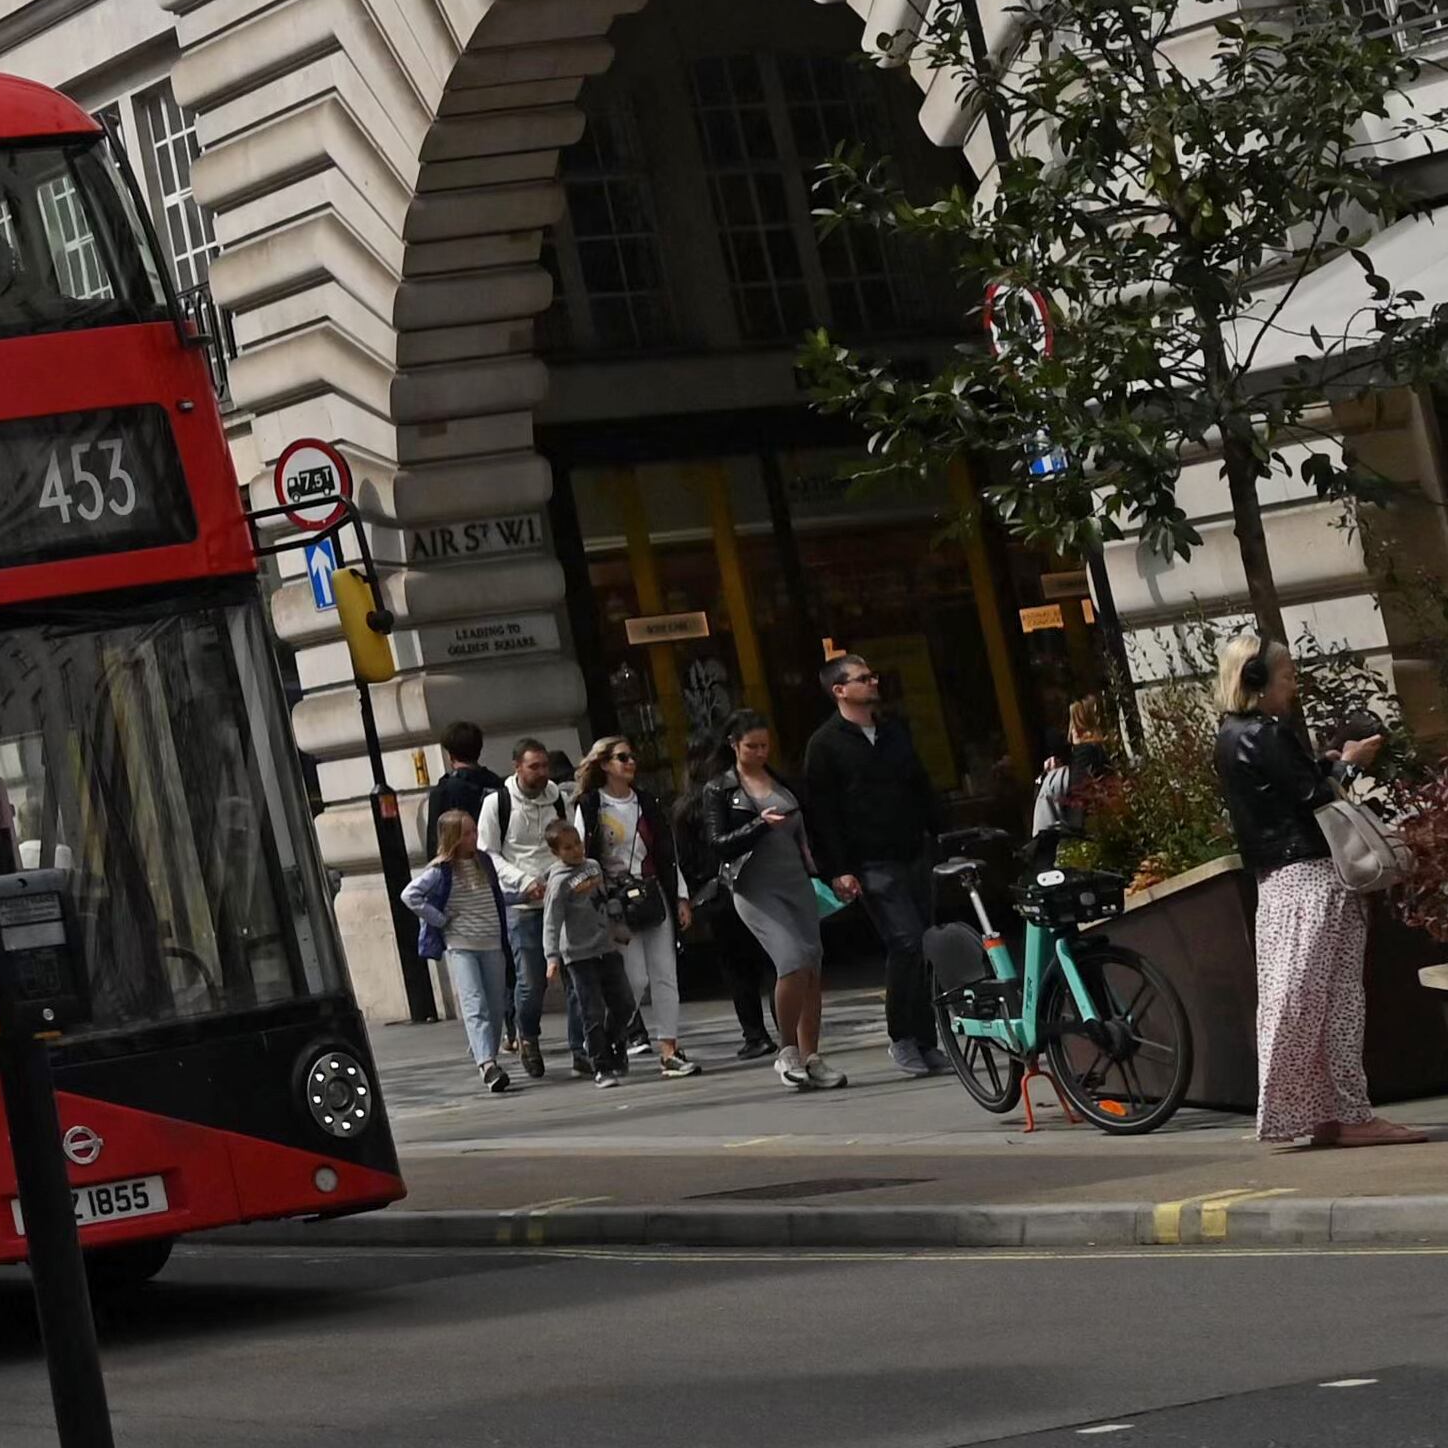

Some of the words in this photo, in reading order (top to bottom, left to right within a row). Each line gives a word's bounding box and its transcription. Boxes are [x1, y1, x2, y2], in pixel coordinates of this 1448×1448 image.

[39, 438, 136, 523] 453
[300, 467, 331, 491] 7.5T
[409, 528, 458, 560] AIR
[448, 642, 489, 656] GOLDEN
[494, 636, 536, 651] SQUARE
[456, 624, 504, 641] LEADING
[507, 623, 520, 634] TO
[88, 1182, 149, 1217] 1855
